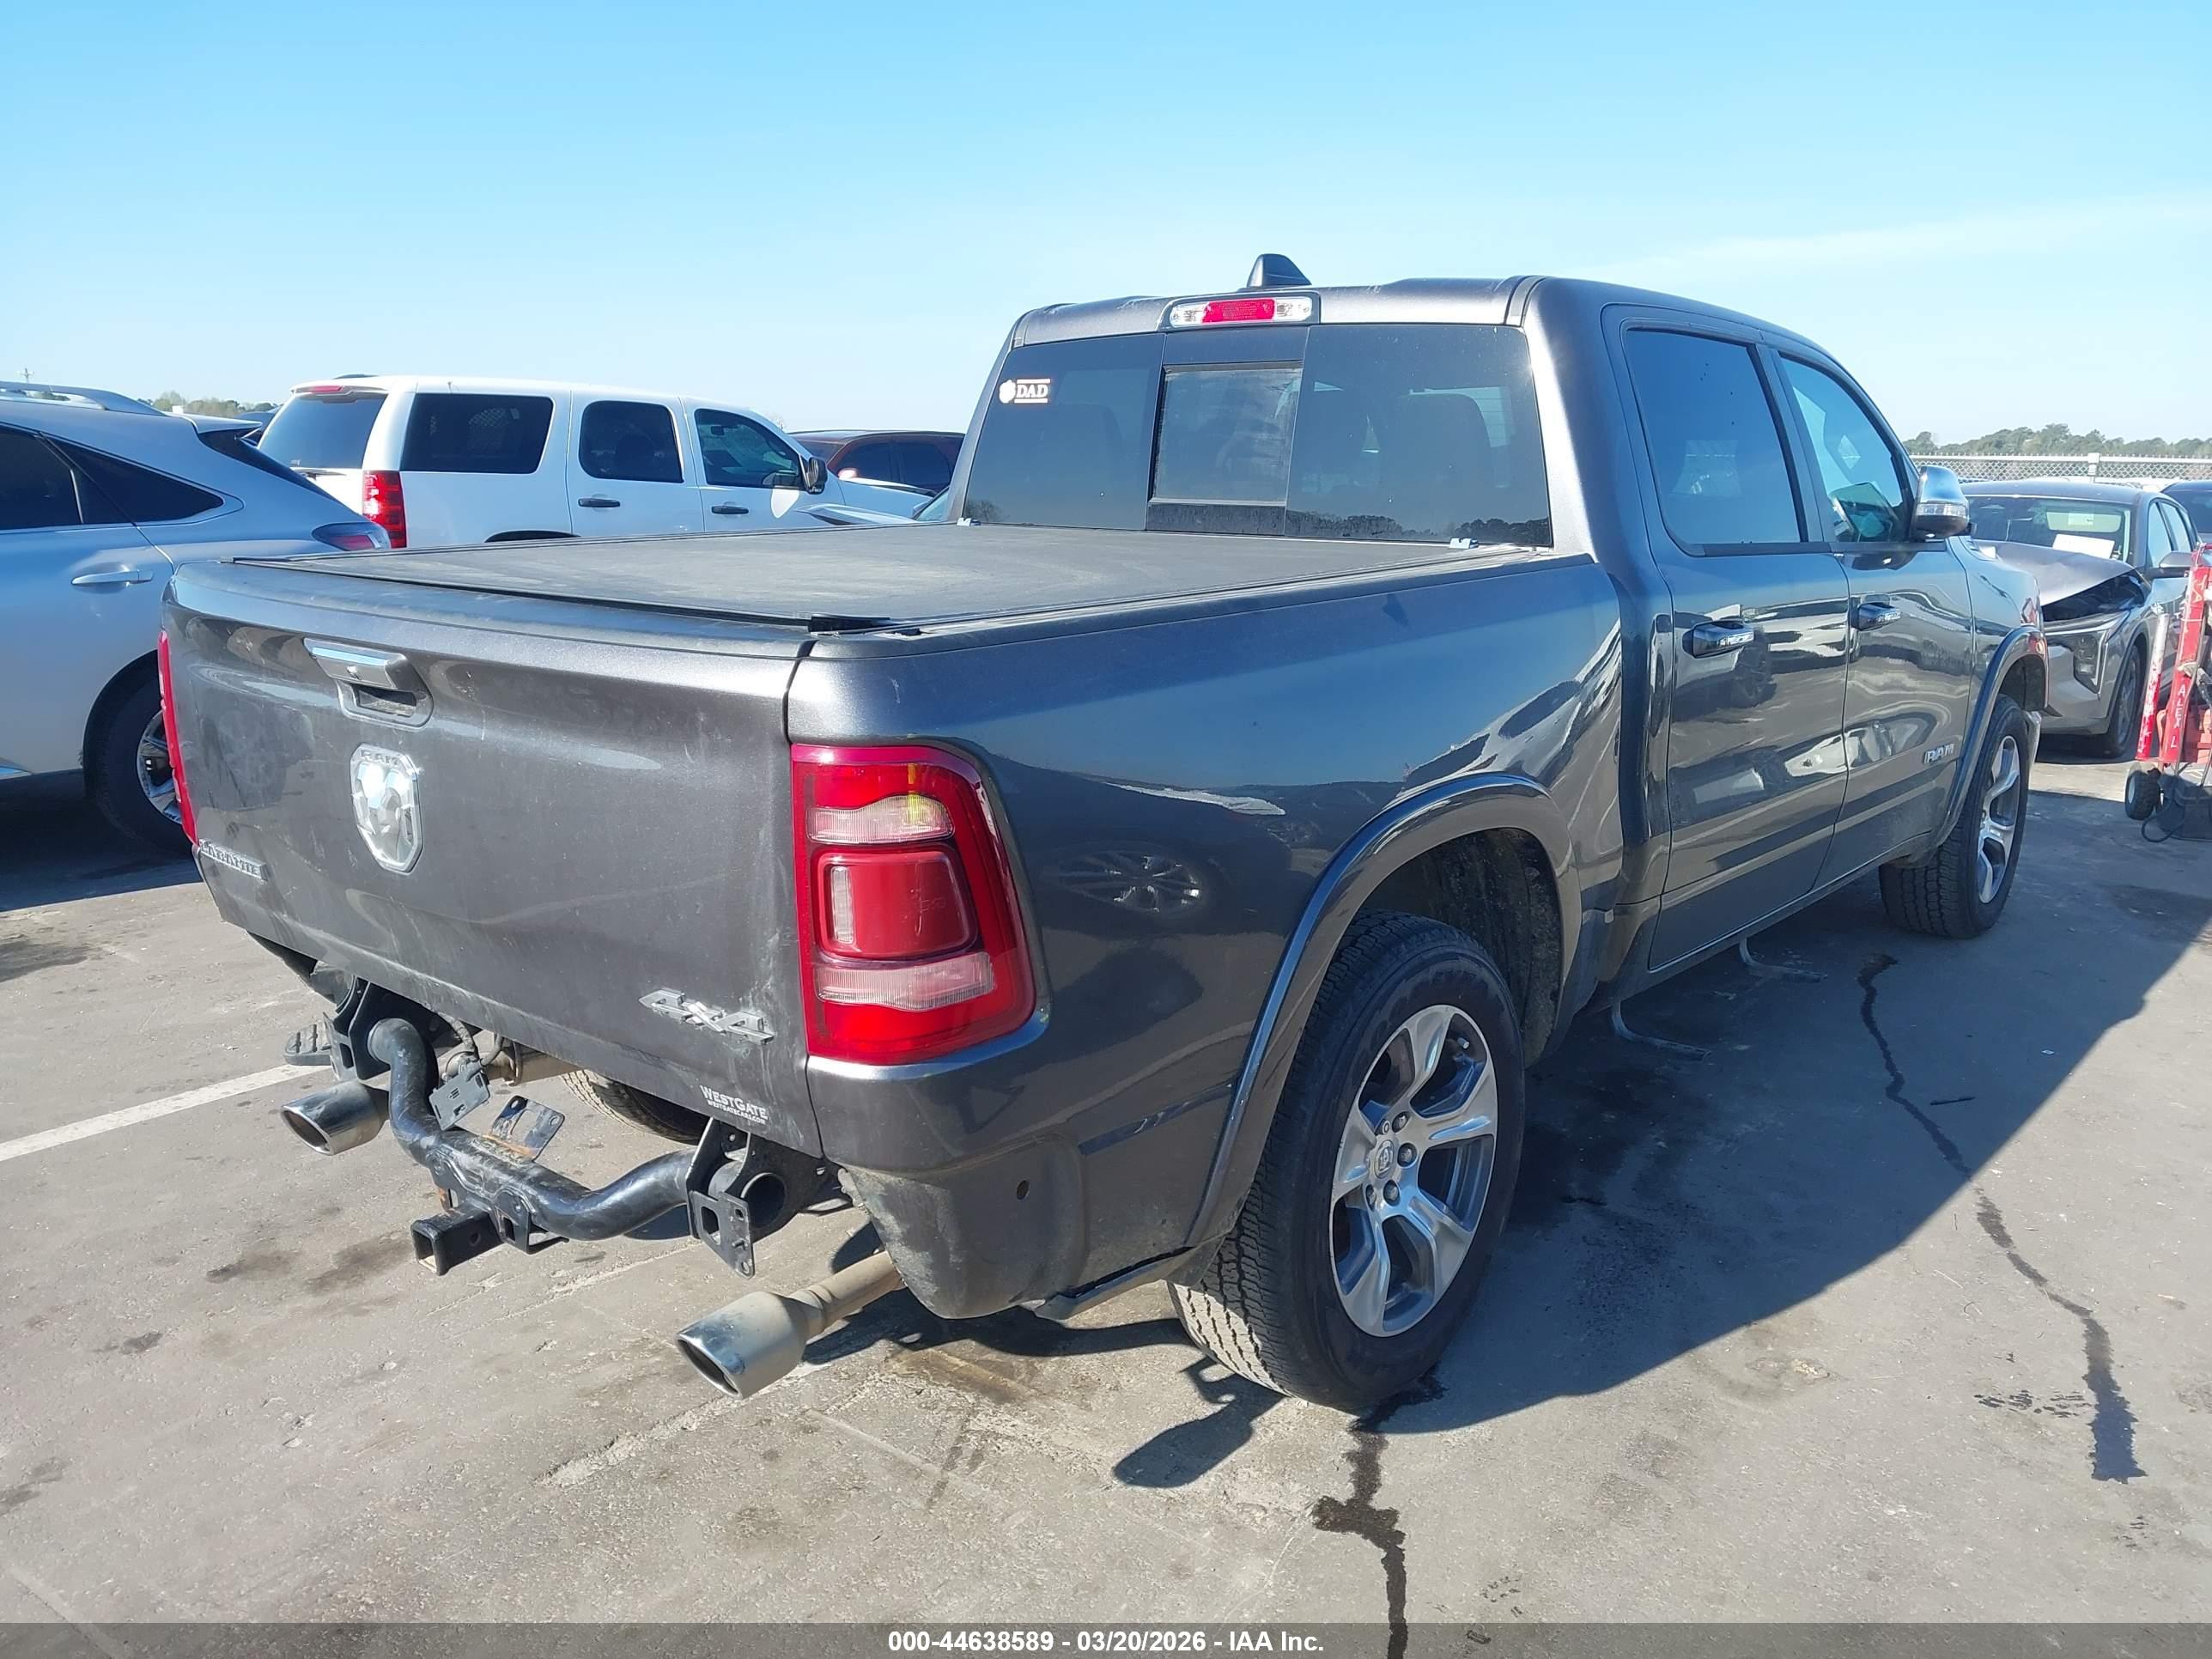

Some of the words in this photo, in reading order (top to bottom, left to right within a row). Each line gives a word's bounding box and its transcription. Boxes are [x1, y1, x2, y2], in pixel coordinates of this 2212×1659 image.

[1016, 384, 1048, 398] DAD
[361, 750, 400, 766] RAM
[1923, 743, 1955, 763] RAM
